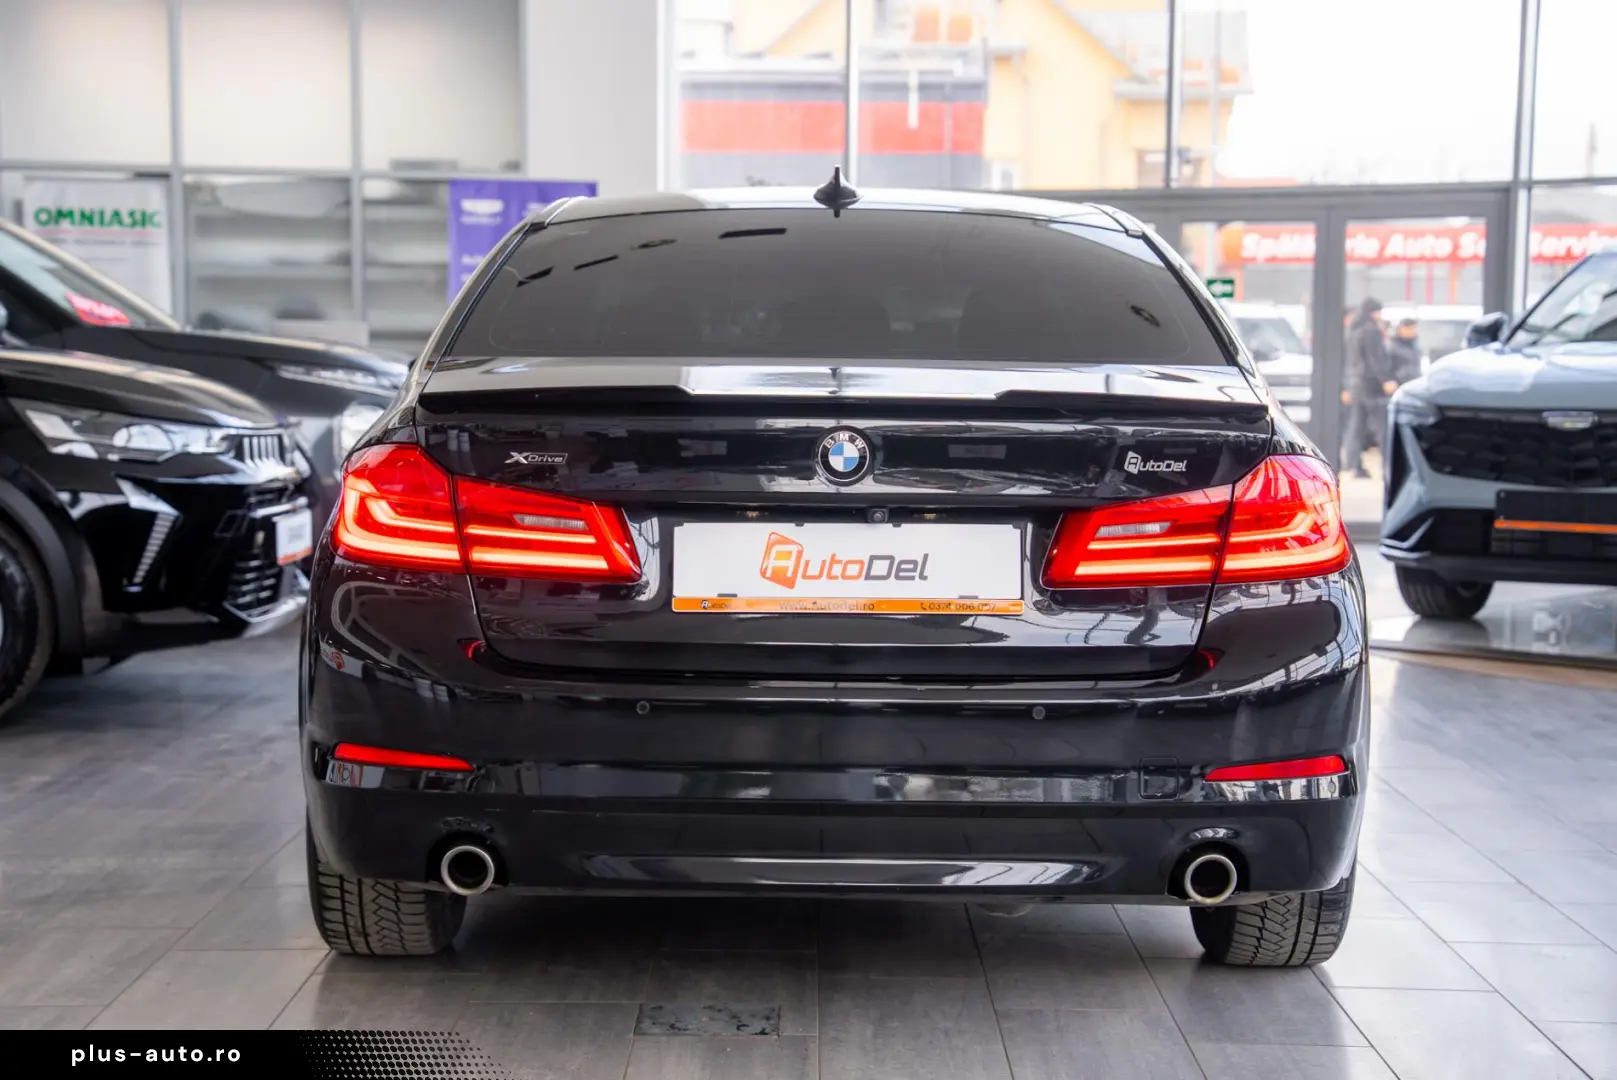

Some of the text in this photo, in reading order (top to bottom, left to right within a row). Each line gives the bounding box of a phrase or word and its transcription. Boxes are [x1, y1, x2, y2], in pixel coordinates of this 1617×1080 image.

[824, 433, 865, 449] BMW
[1124, 451, 1187, 474] AutoDel
[760, 532, 929, 589] AutoDel
